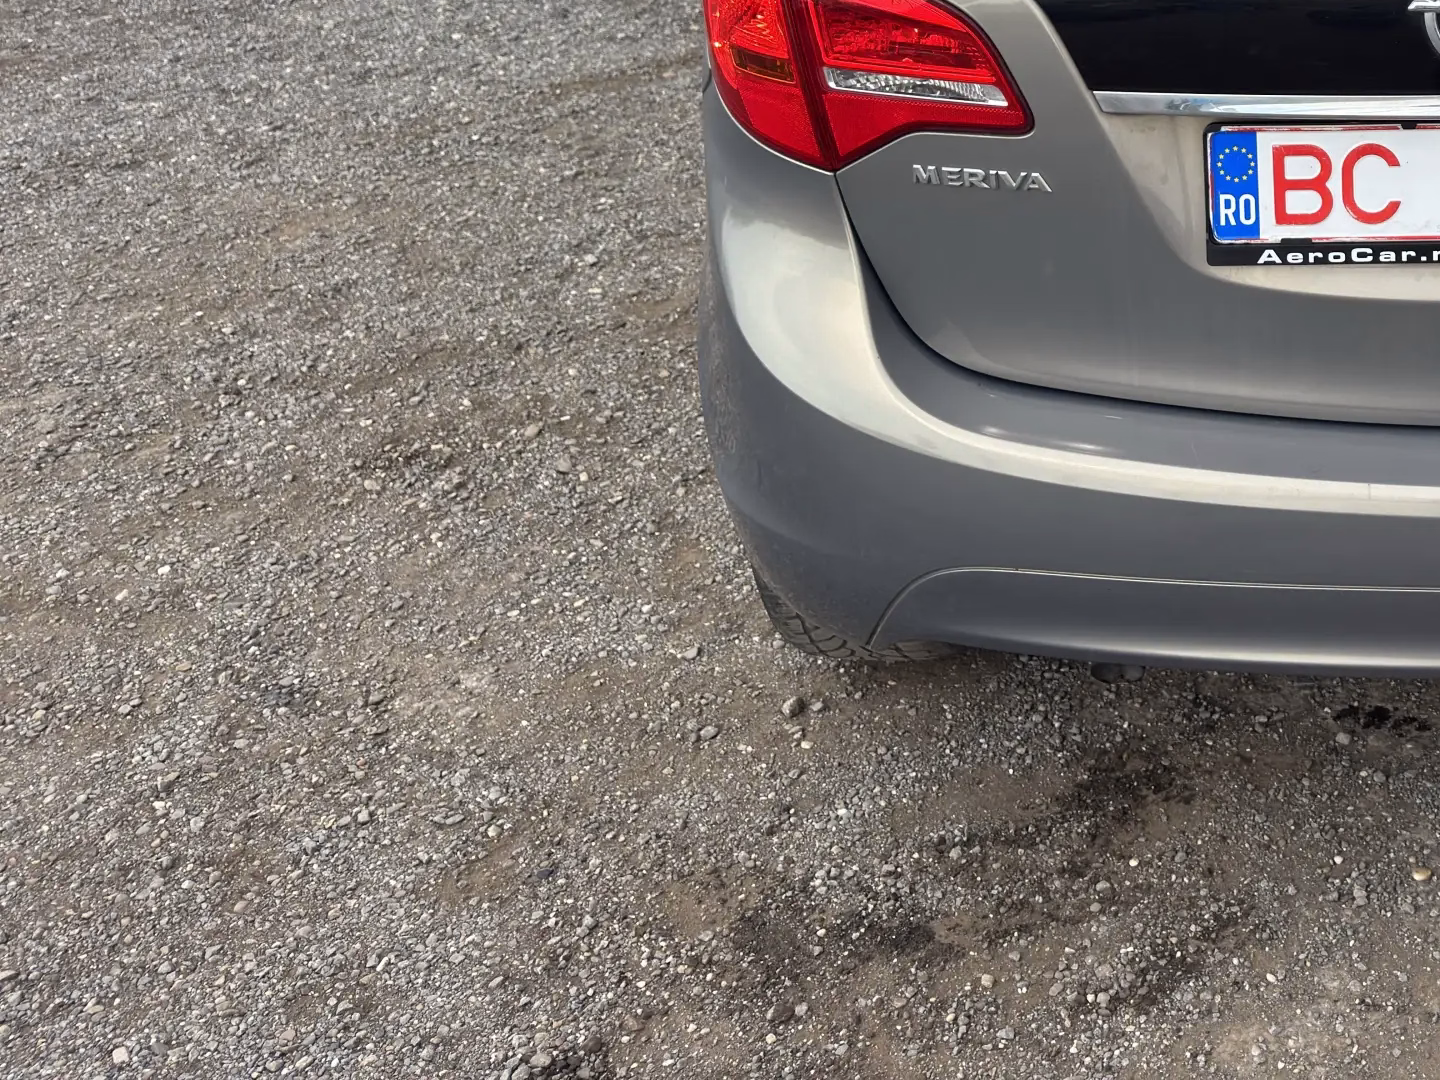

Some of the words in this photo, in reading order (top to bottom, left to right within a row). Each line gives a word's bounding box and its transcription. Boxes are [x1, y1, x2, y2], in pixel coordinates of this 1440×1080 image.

[912, 163, 1053, 193] MERIVA
[1272, 142, 1402, 226] BC
[1219, 193, 1257, 228] RO
